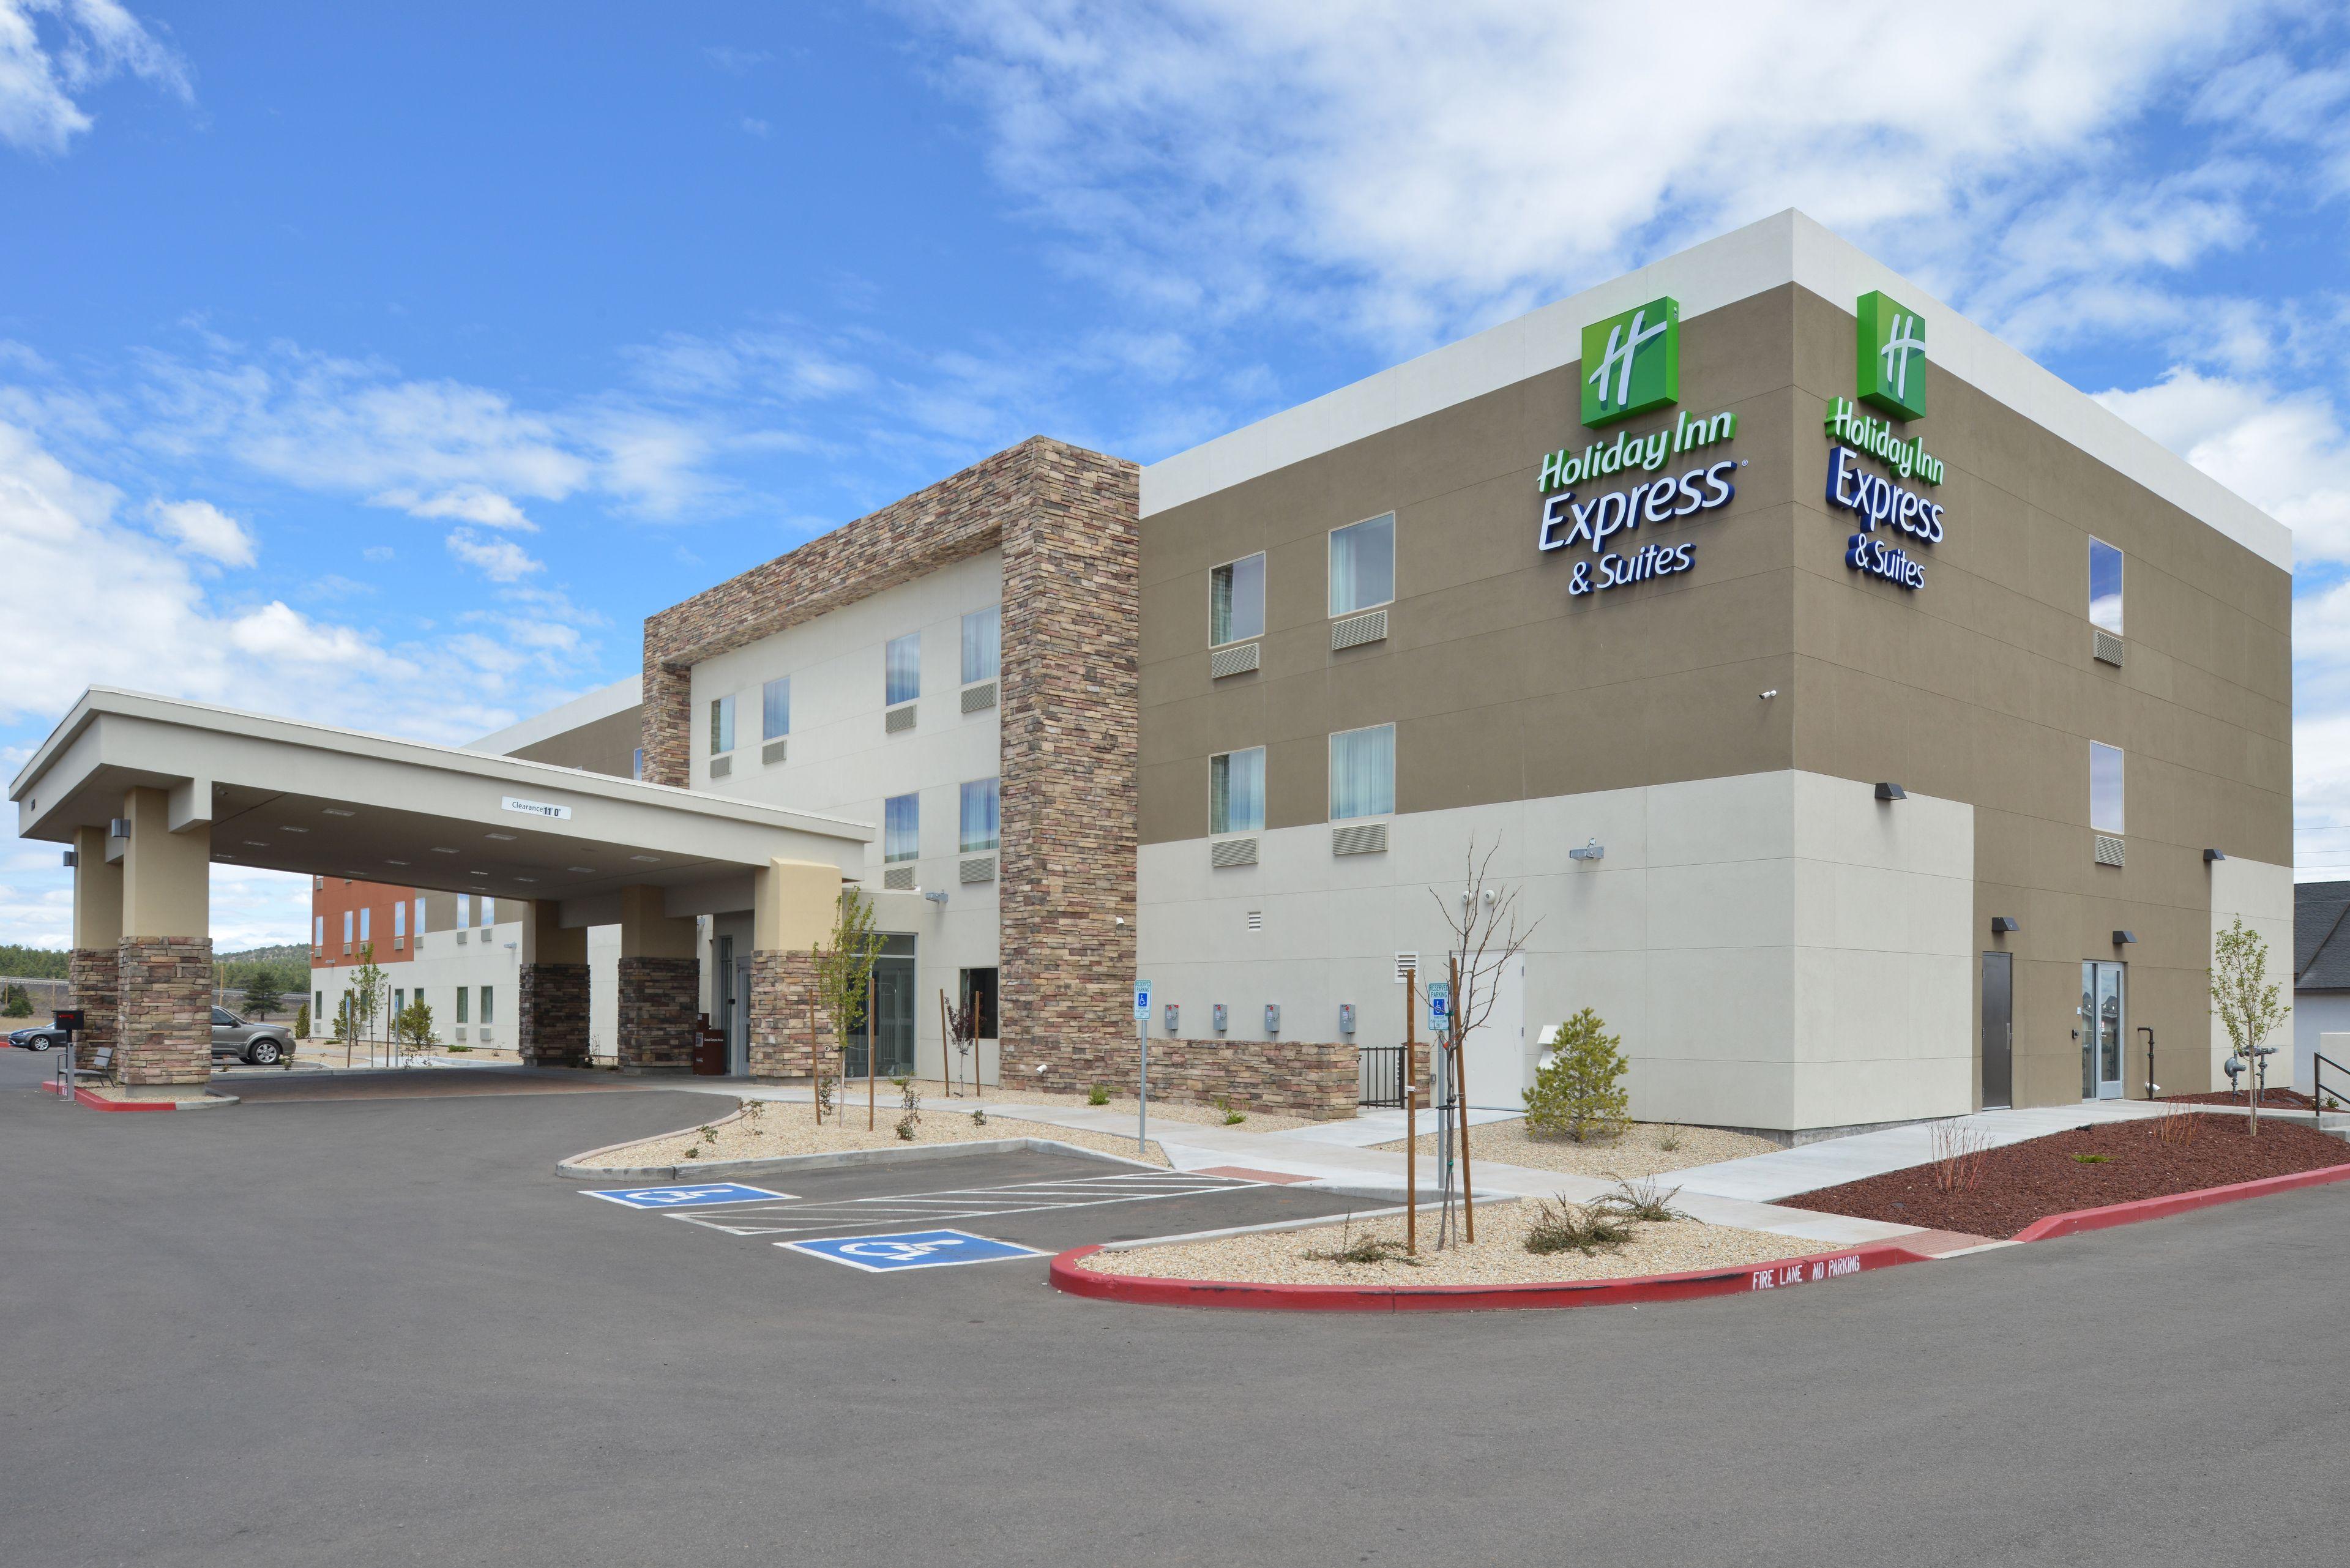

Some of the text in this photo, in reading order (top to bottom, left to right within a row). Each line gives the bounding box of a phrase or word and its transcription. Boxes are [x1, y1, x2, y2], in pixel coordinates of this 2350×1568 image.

[1537, 411, 1736, 493] Holiday Inn
[1830, 396, 1944, 485] Holiday Inn
[1539, 460, 1736, 553] Express
[1830, 446, 1944, 545] Express
[1569, 542, 1695, 595] & Suites
[1851, 532, 1925, 589] & Suites
[512, 801, 543, 812] Clearance
[1753, 1255, 1860, 1290] FIRE LANE NO PARKING
